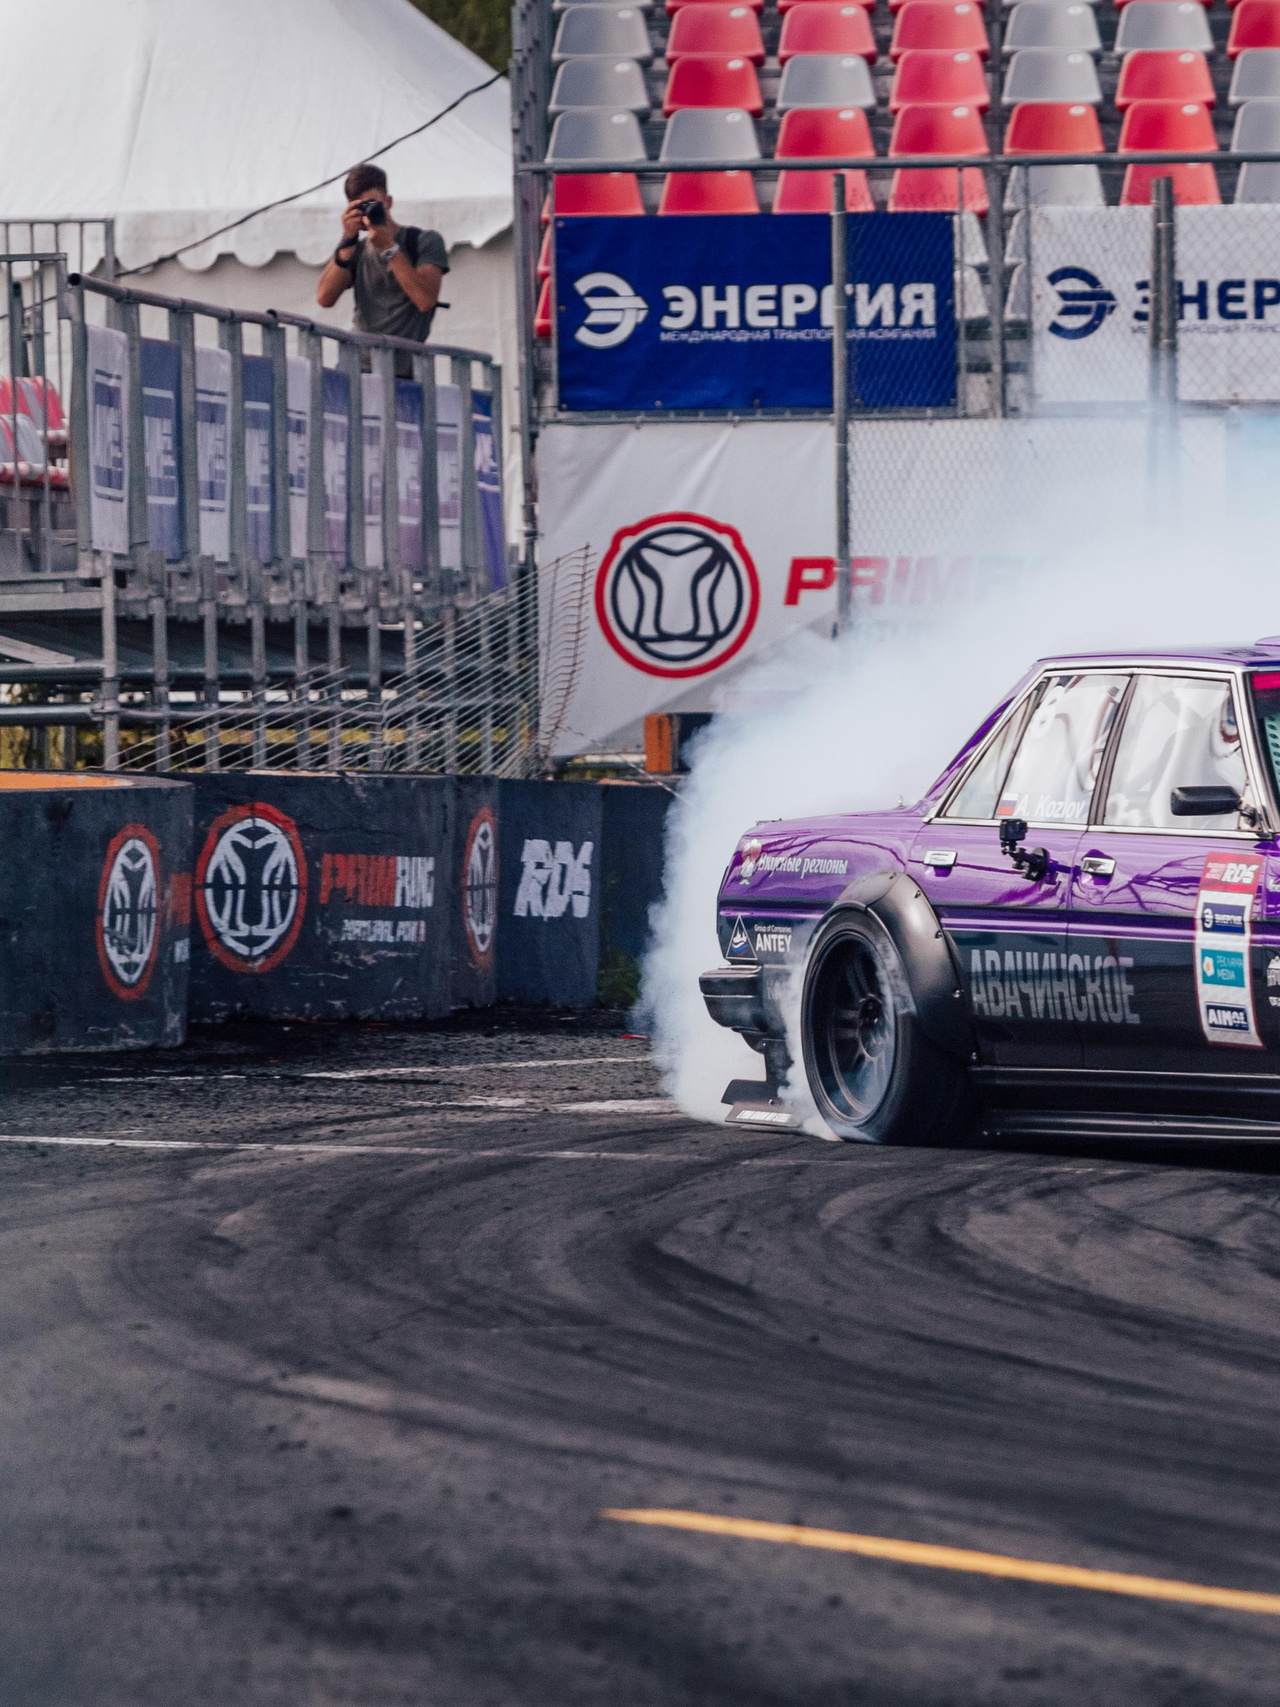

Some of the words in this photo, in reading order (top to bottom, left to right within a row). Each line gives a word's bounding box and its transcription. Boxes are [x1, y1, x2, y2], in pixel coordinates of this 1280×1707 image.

[659, 282, 937, 330] ЭНЕРГИЯ
[1035, 795, 1086, 819] Kozlov
[1221, 862, 1260, 884] RDS
[755, 933, 792, 952] ANTEY
[970, 949, 1141, 1024] АВАЧИНСКОЕ
